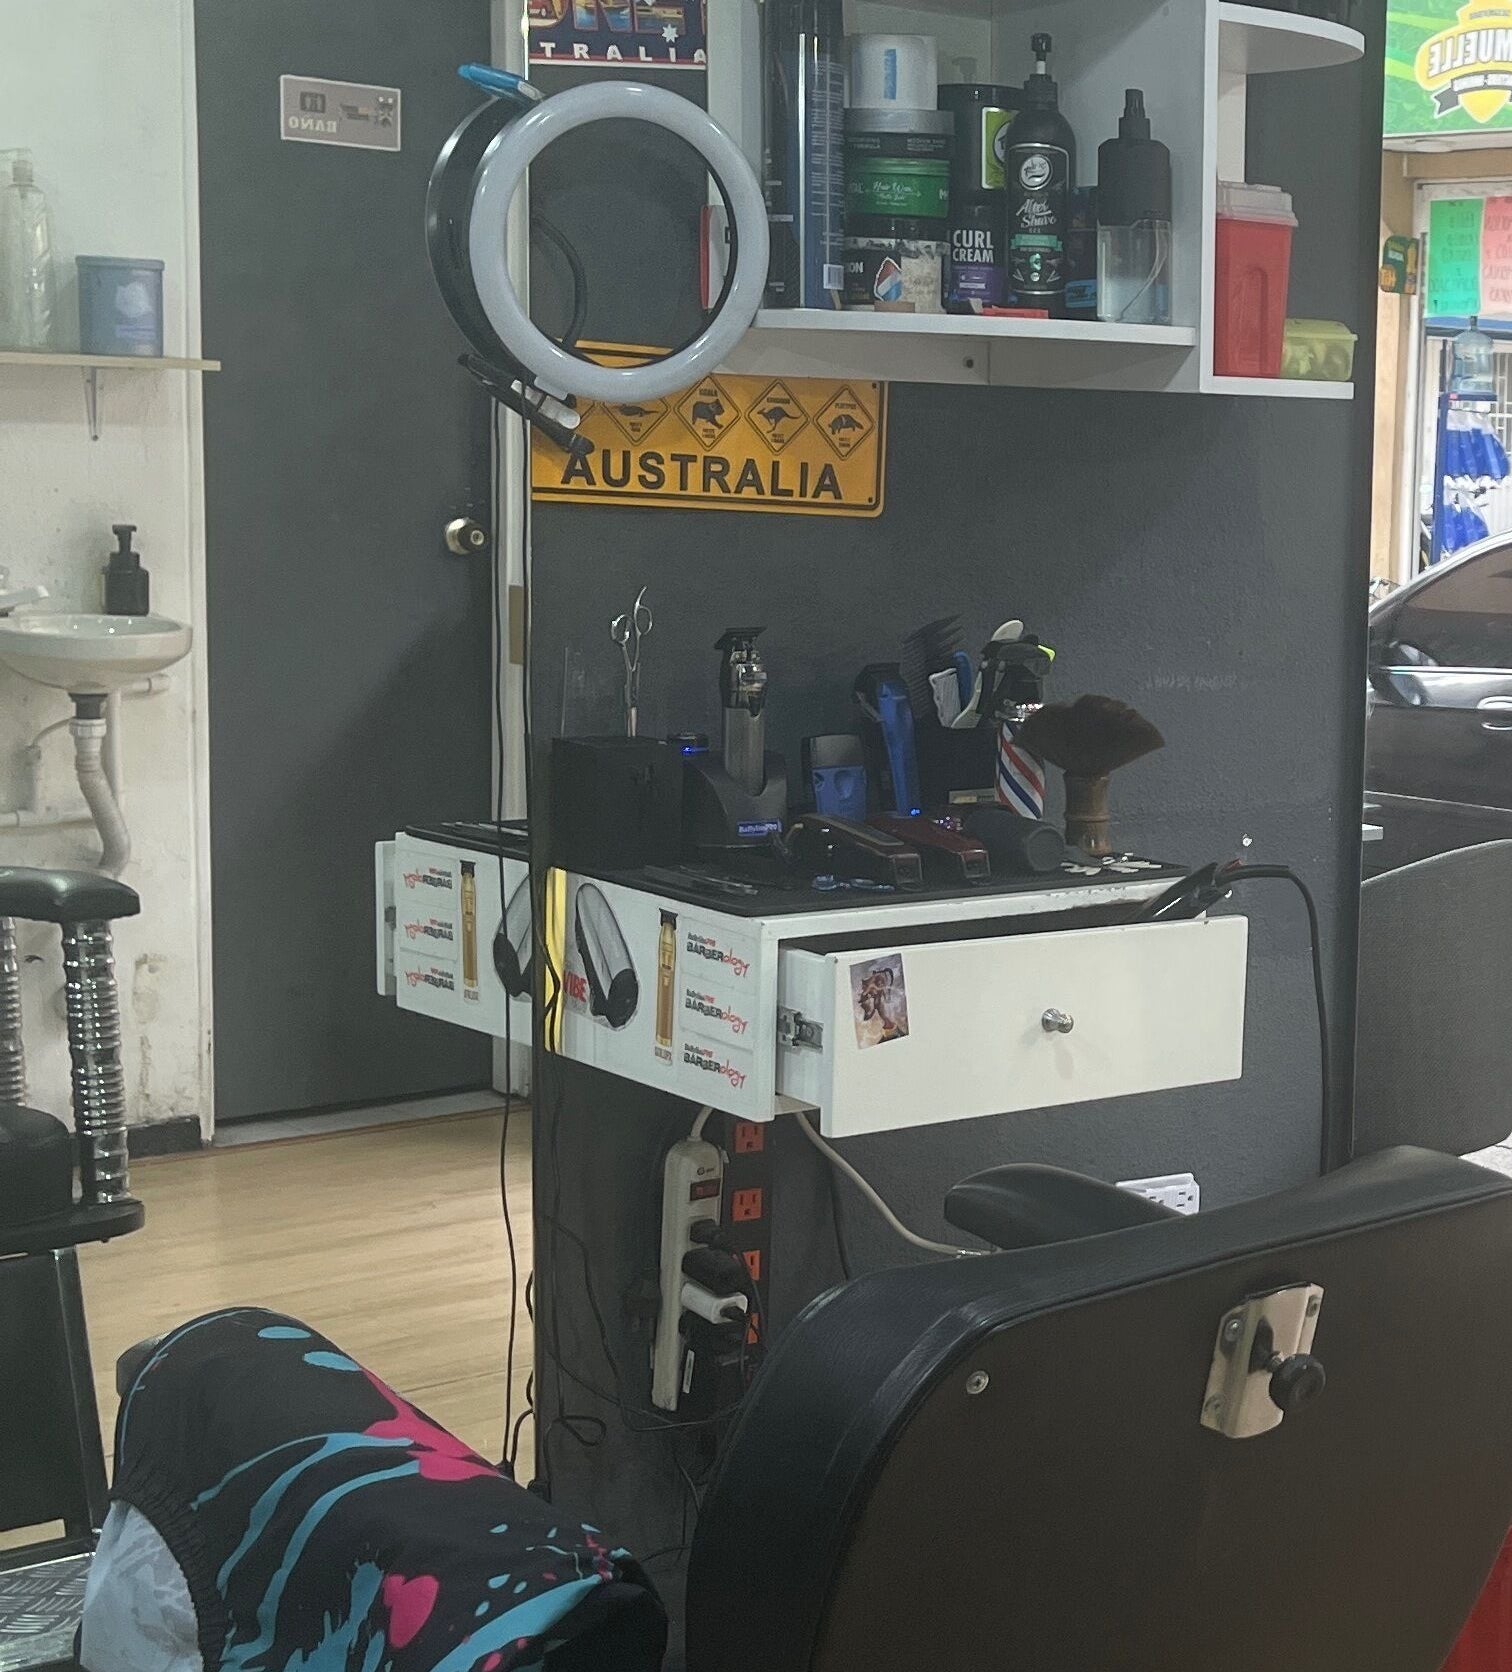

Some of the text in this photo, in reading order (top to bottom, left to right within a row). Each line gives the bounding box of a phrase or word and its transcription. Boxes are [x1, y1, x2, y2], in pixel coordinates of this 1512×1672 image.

[952, 229, 994, 249] CURL
[952, 249, 994, 263] CREAM
[560, 449, 843, 500] AUSTRALIA
